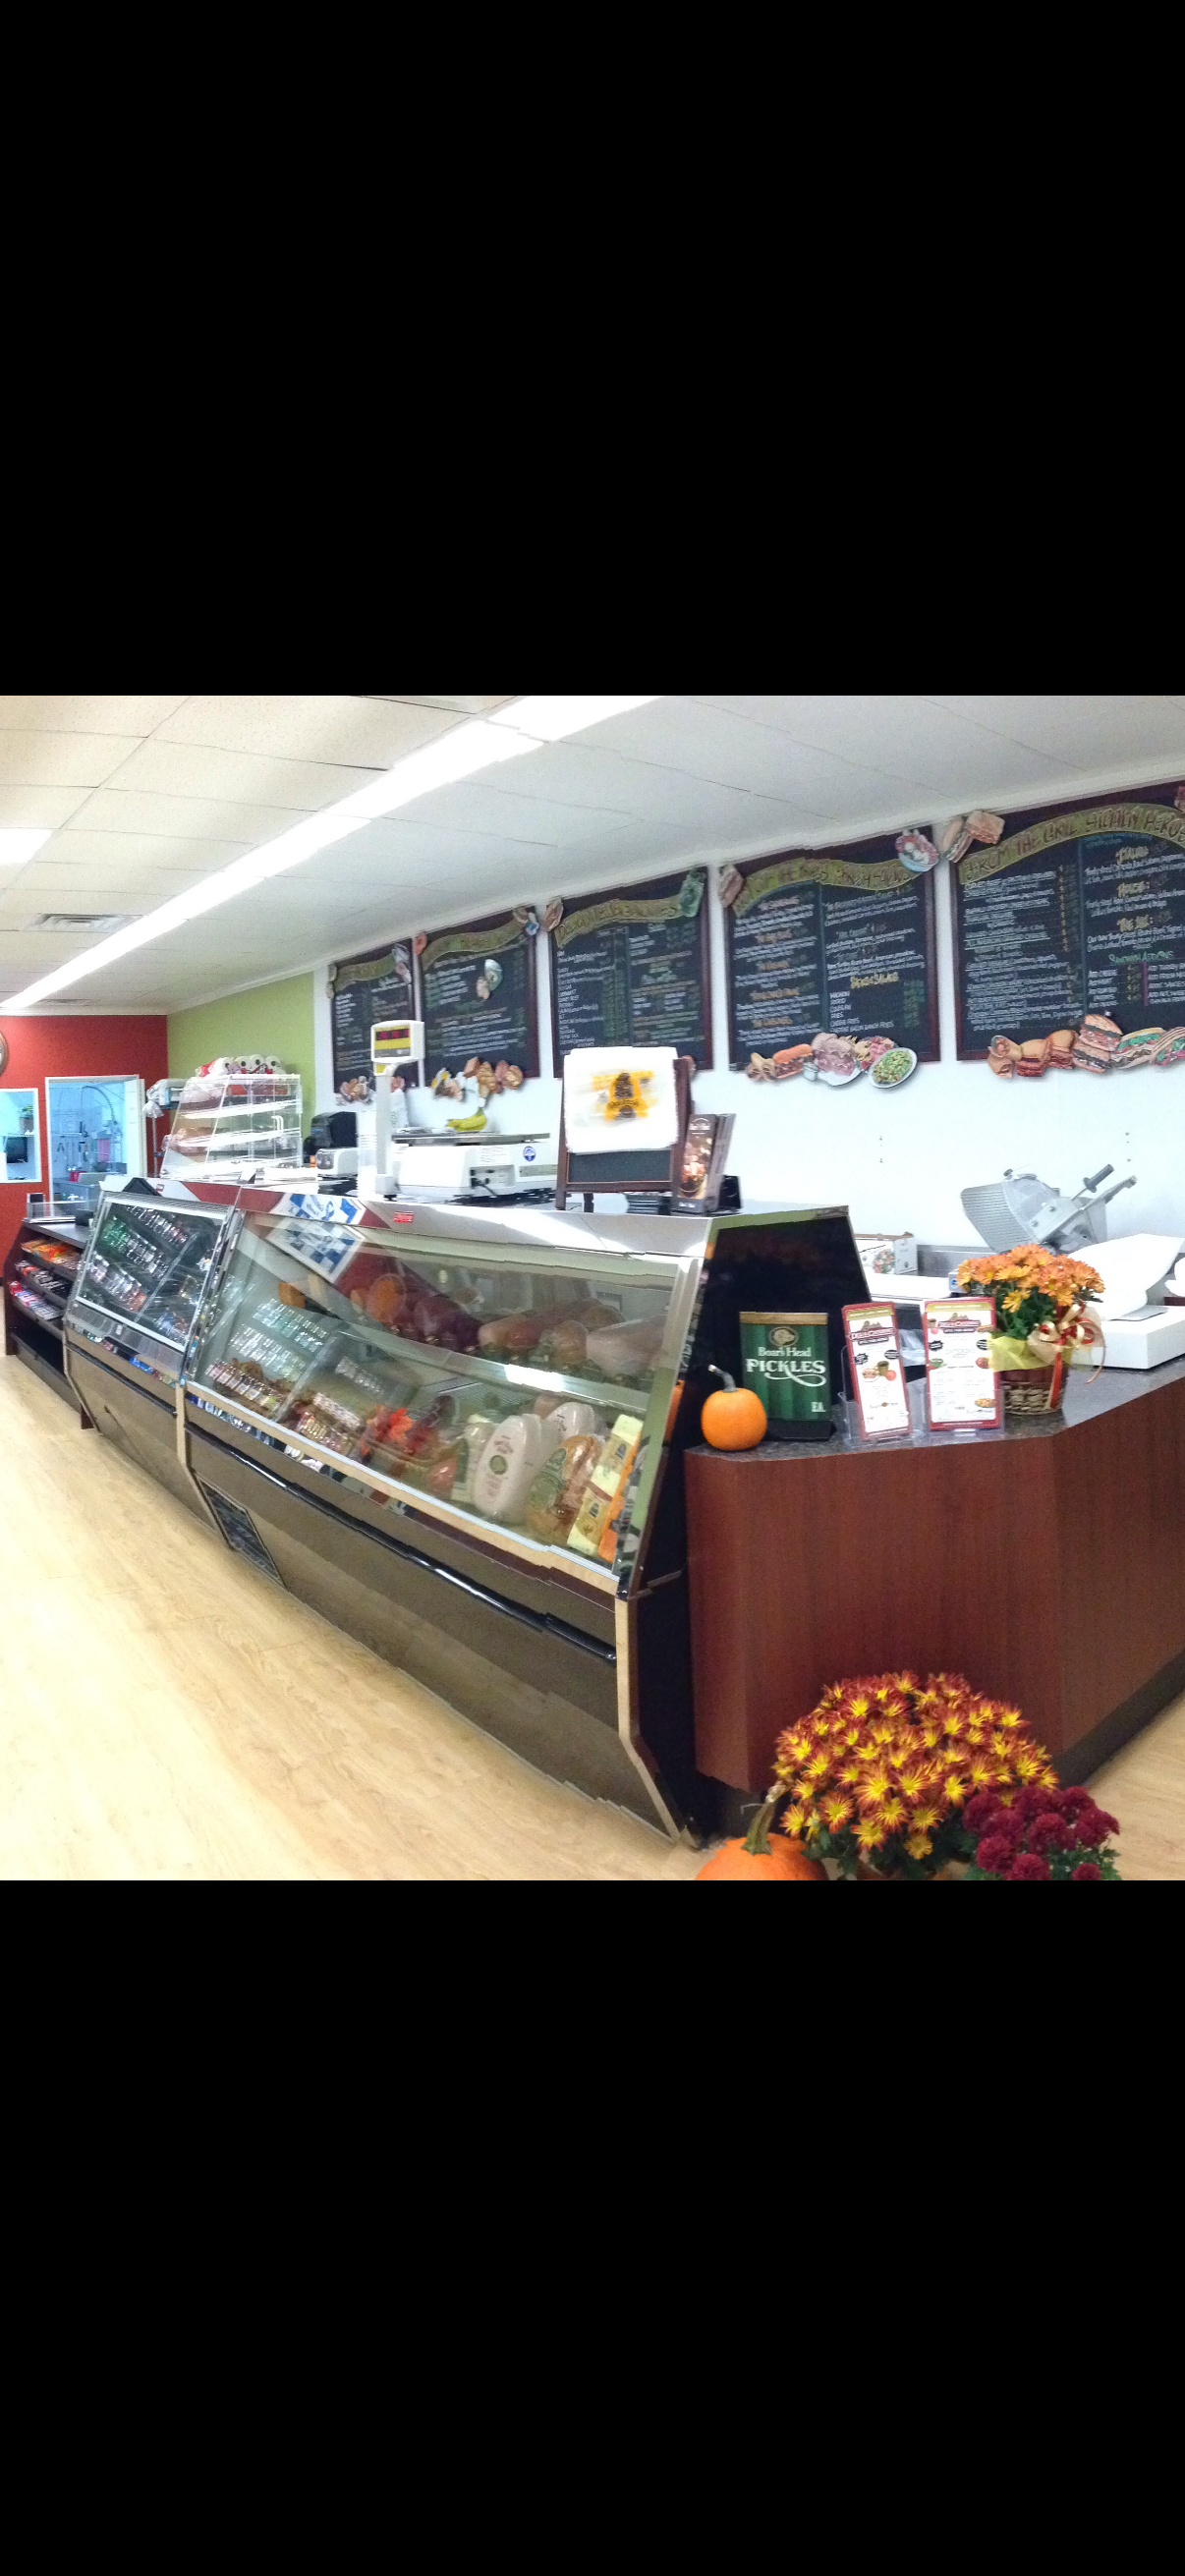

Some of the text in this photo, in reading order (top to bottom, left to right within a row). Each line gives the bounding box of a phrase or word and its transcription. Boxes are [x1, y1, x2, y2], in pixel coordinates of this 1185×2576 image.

[964, 844, 1010, 880] FROM
[1015, 832, 1040, 856] THE
[786, 1346, 812, 1357] Head
[745, 1359, 826, 1386] PICKLES
